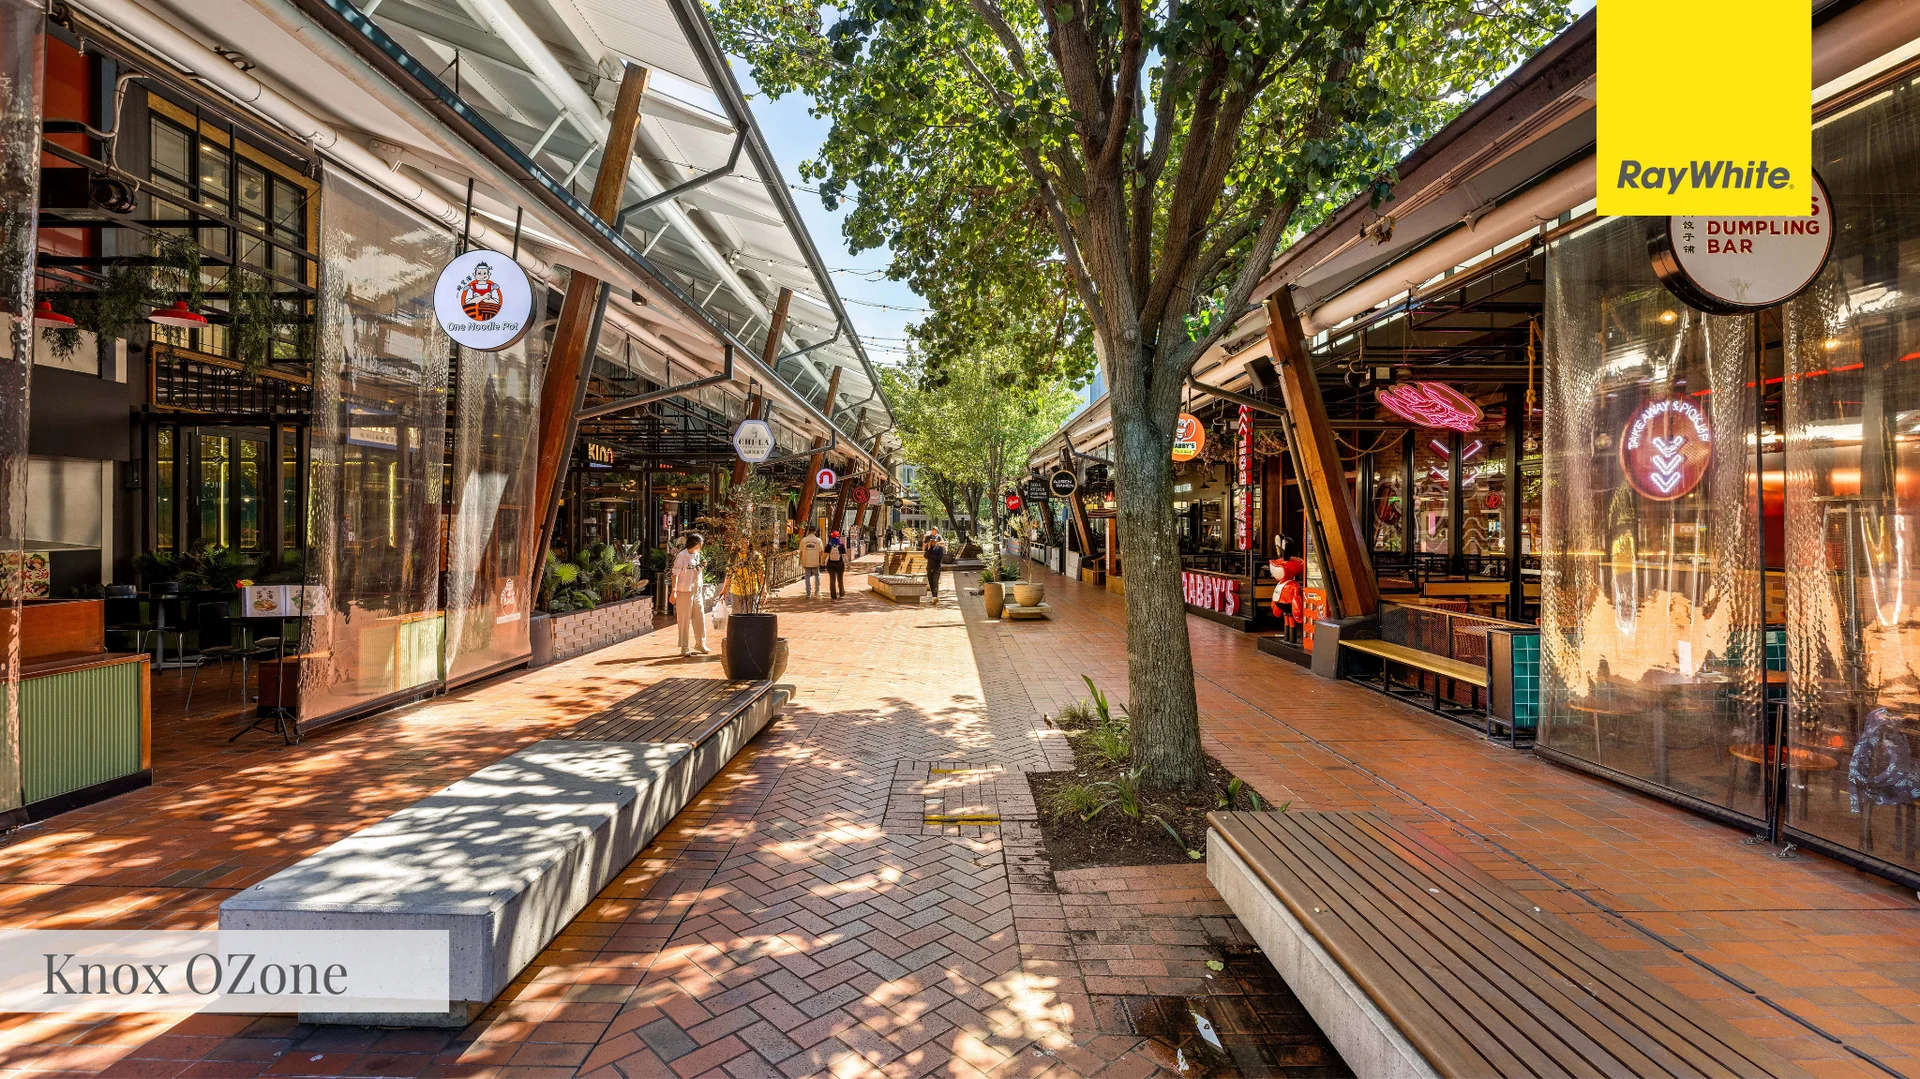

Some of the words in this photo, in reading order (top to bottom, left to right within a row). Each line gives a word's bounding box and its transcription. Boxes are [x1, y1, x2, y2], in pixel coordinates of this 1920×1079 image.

[1682, 216, 1695, 254] 饺子铺
[1706, 220, 1820, 235] DUMPLING
[1707, 239, 1753, 254] BAR
[447, 321, 466, 332] One
[468, 321, 501, 332] Noodle
[503, 321, 519, 331] Pot
[1627, 420, 1646, 450] TAKE
[1642, 401, 1670, 423] AWAY
